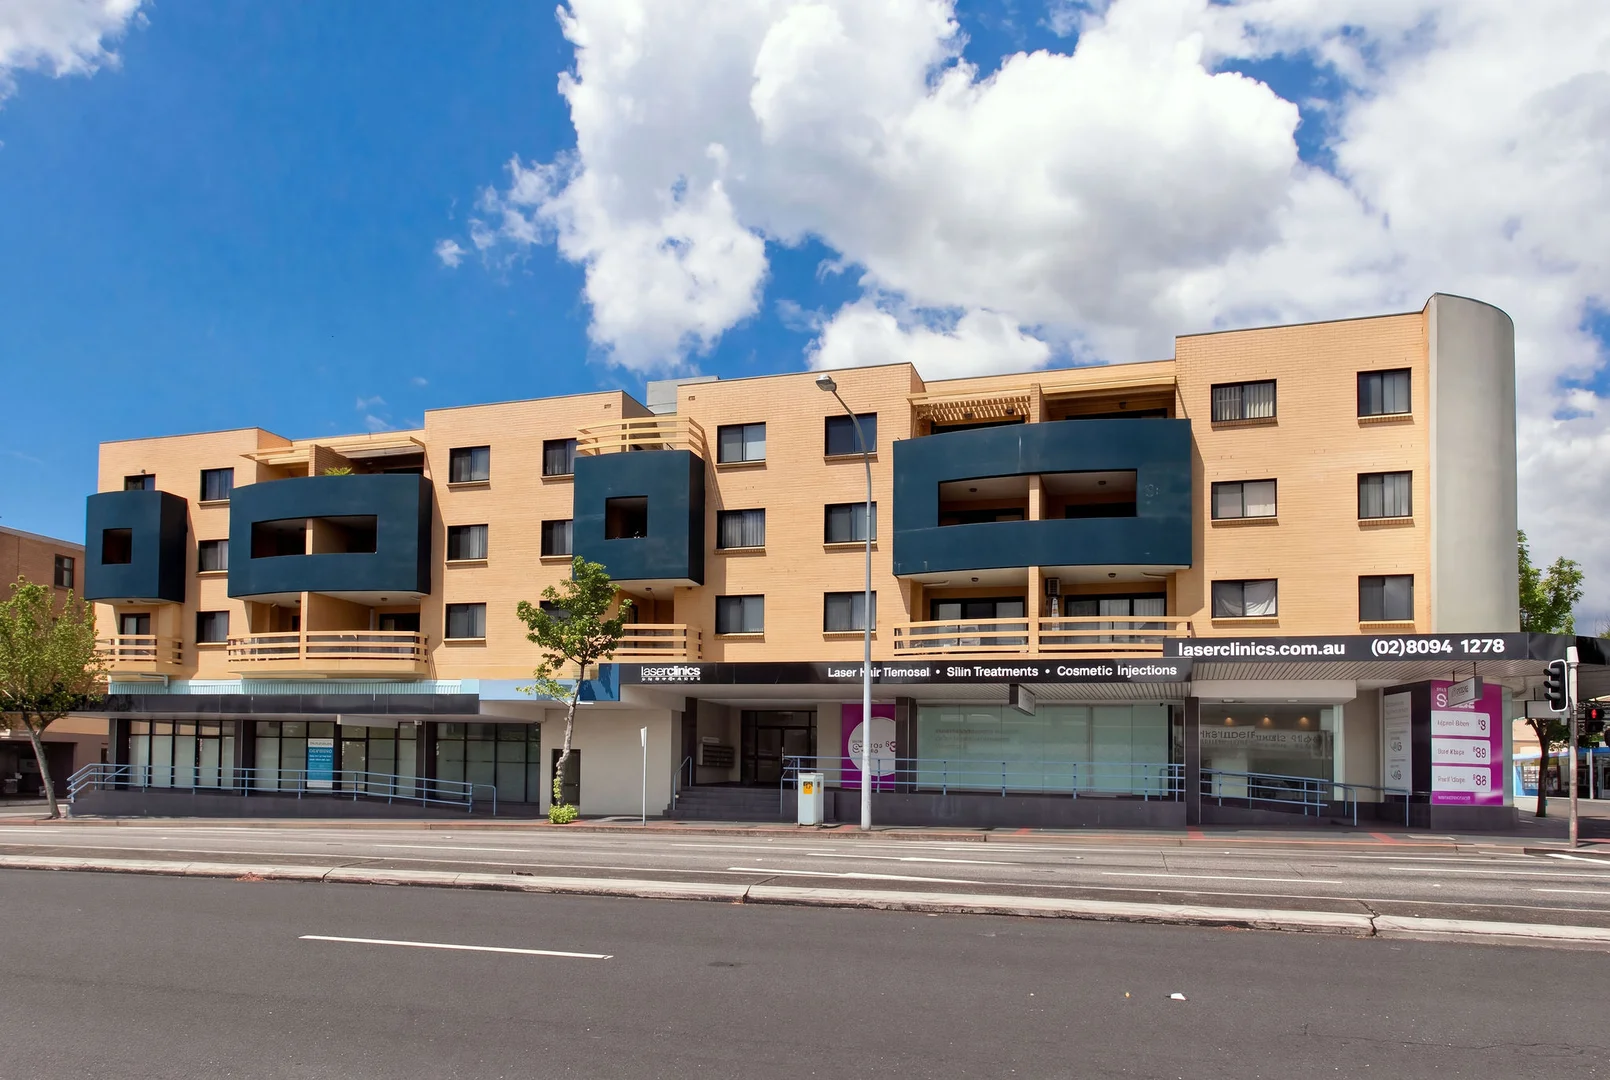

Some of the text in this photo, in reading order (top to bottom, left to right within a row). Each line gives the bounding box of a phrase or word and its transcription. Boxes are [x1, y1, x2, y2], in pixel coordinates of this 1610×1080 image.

[1178, 638, 1505, 657] laserclinics.com.au (02)8094 1278
[641, 666, 701, 676] laserclinics
[828, 667, 857, 677] Laser
[974, 666, 1039, 677] Treatments
[1057, 666, 1113, 676] Cosmetic
[1117, 665, 1178, 679] Injections
